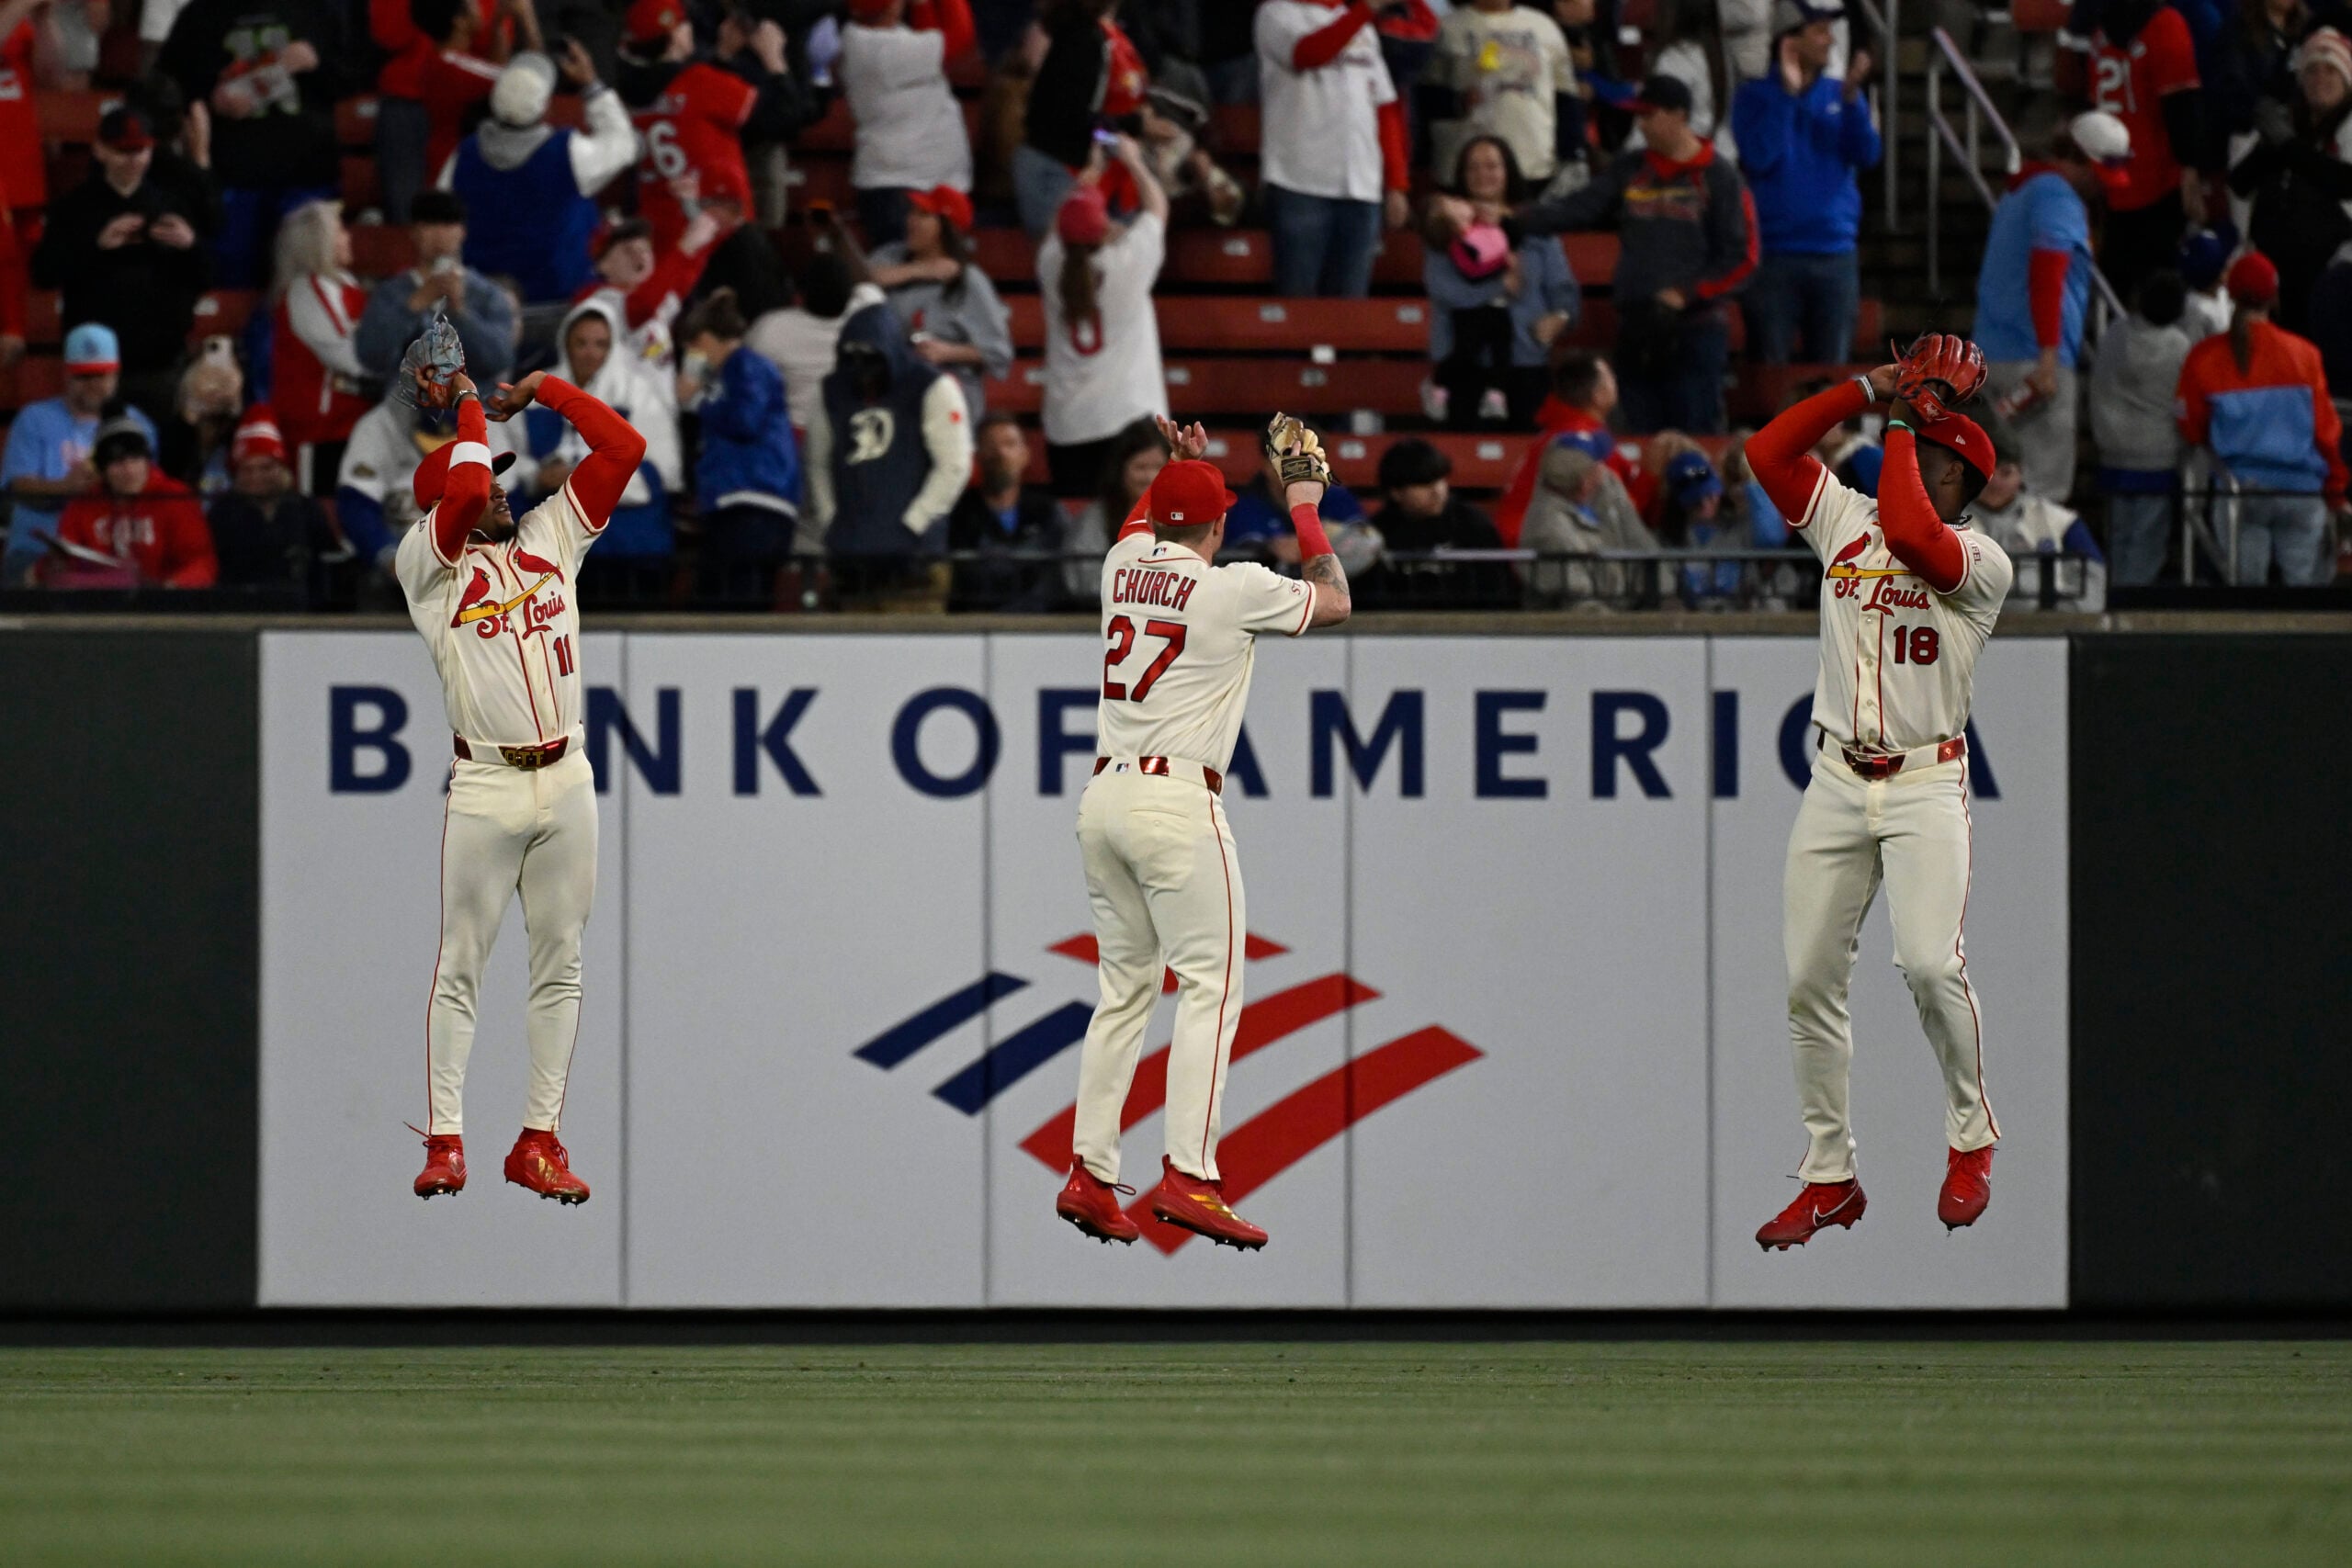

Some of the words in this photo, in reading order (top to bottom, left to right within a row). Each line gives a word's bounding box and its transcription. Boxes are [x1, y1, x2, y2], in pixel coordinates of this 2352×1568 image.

[640, 119, 687, 180] 6
[1113, 569, 1197, 612] CHURCH
[1835, 562, 1860, 600] St.
[1862, 574, 1931, 617] Louis
[476, 600, 515, 639] St.
[522, 591, 566, 640] Louis
[553, 634, 574, 677] 11
[1103, 615, 1188, 703] 27
[1894, 625, 1939, 665] 18
[330, 686, 822, 795] BNK
[891, 688, 1100, 797] OF
[501, 749, 545, 767] OTT
